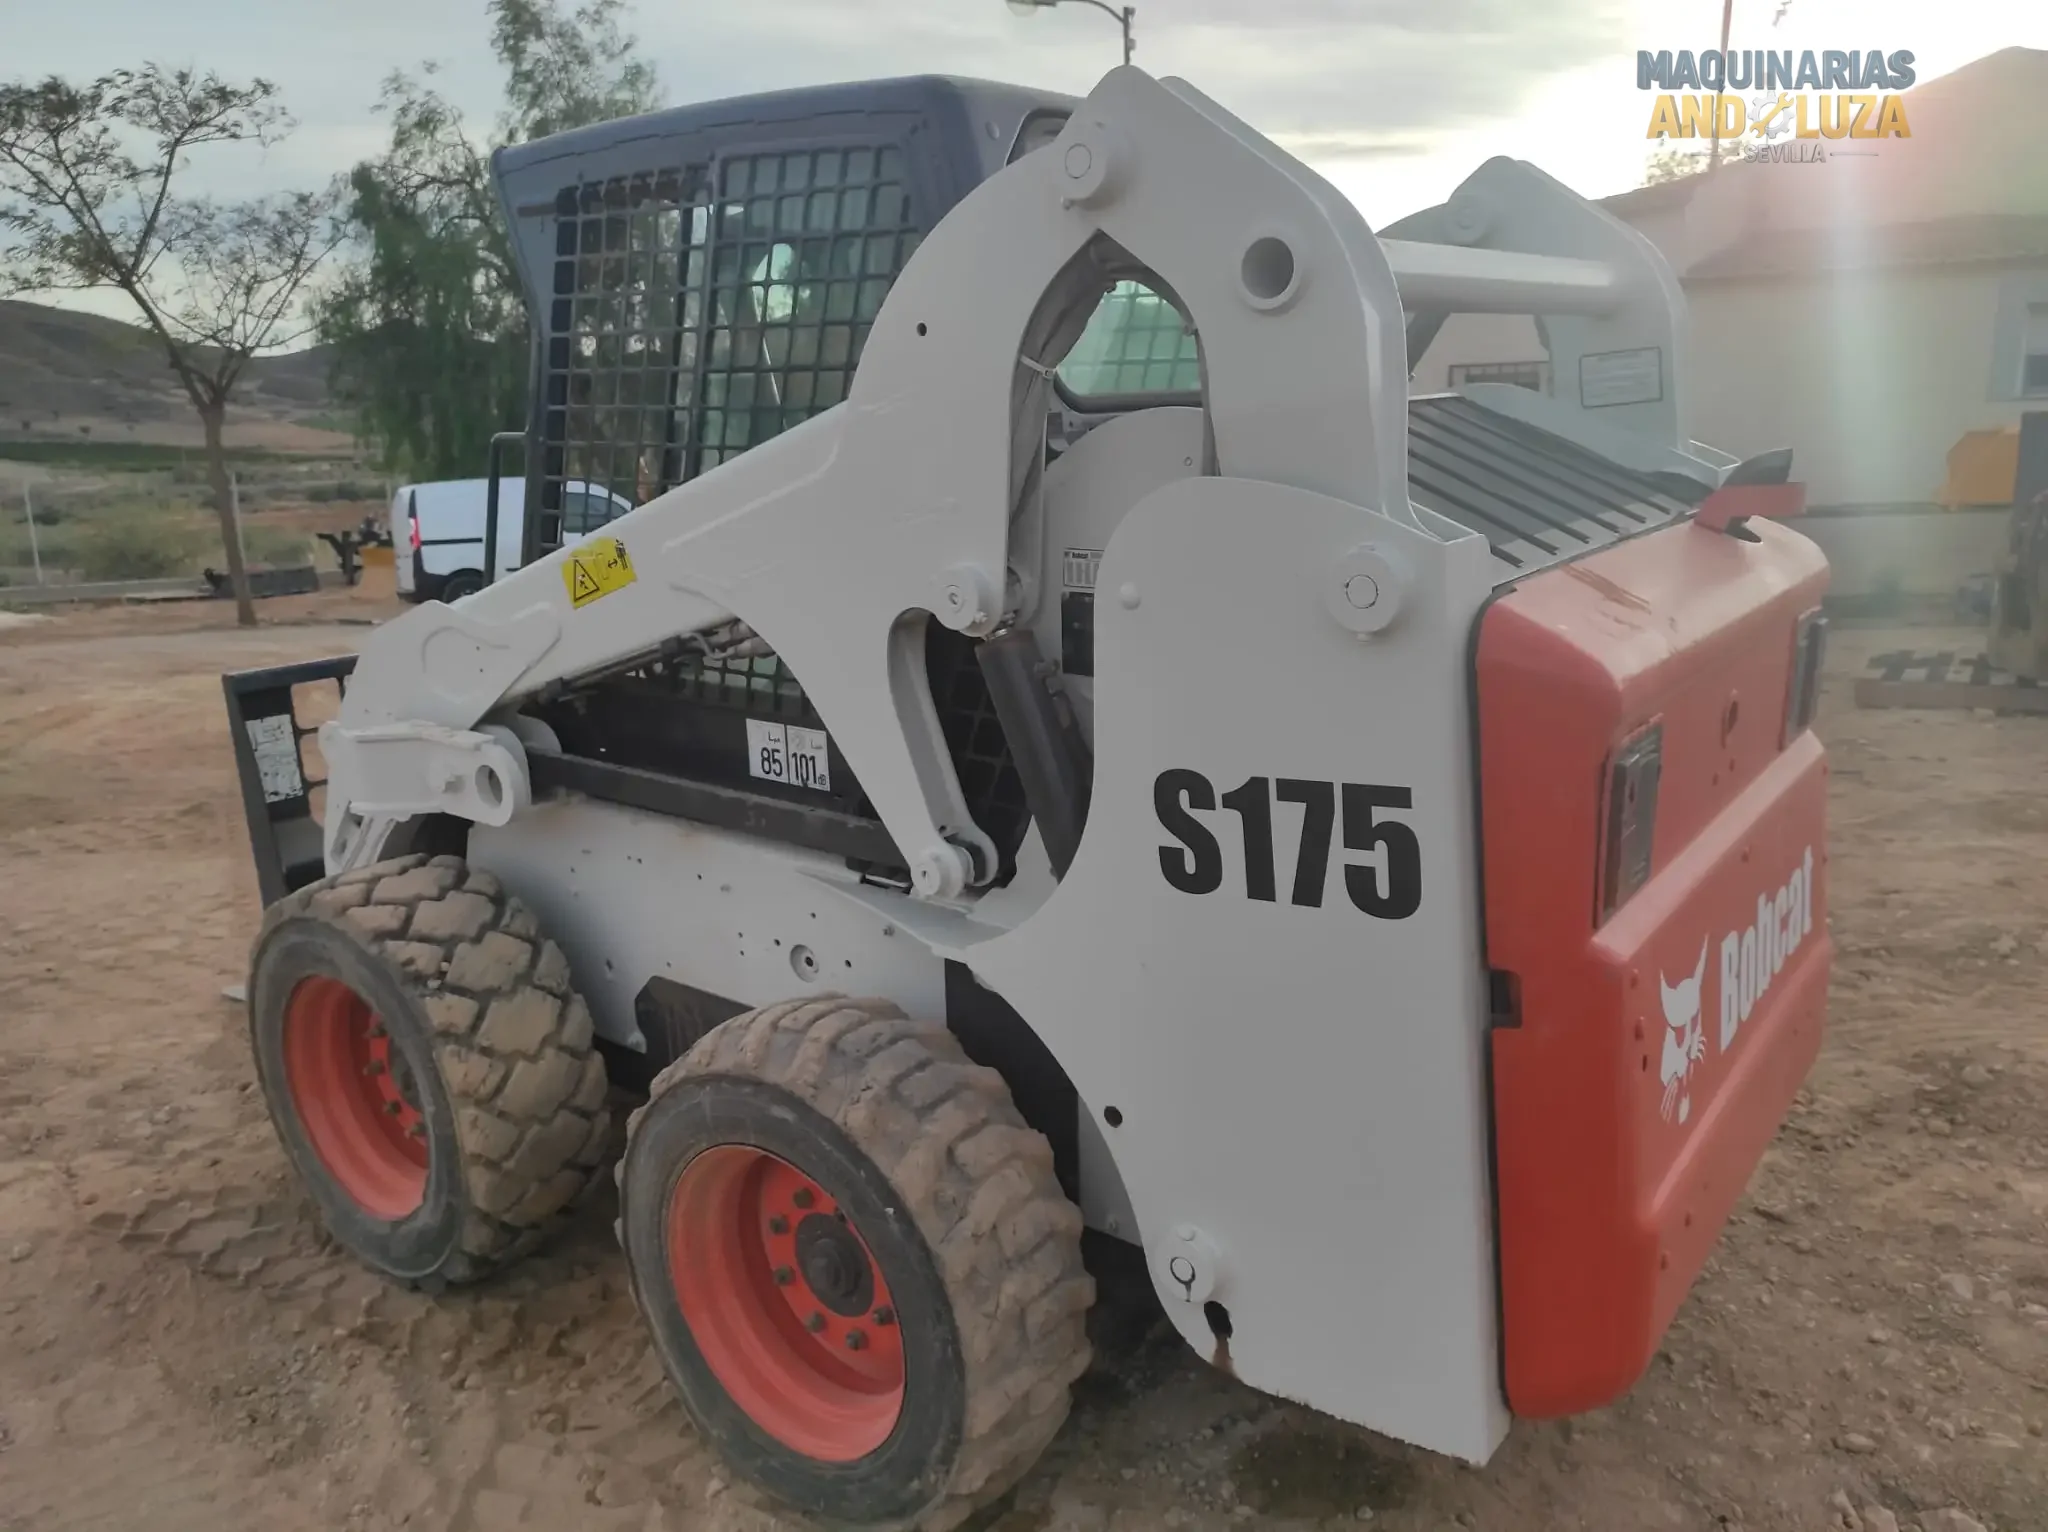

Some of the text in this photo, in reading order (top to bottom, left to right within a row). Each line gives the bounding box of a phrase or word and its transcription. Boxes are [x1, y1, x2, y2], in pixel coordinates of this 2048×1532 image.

[761, 747, 783, 777] 85
[792, 752, 817, 785] 101
[1154, 768, 1422, 920] S175
[1720, 844, 1814, 1056] Bobcat
